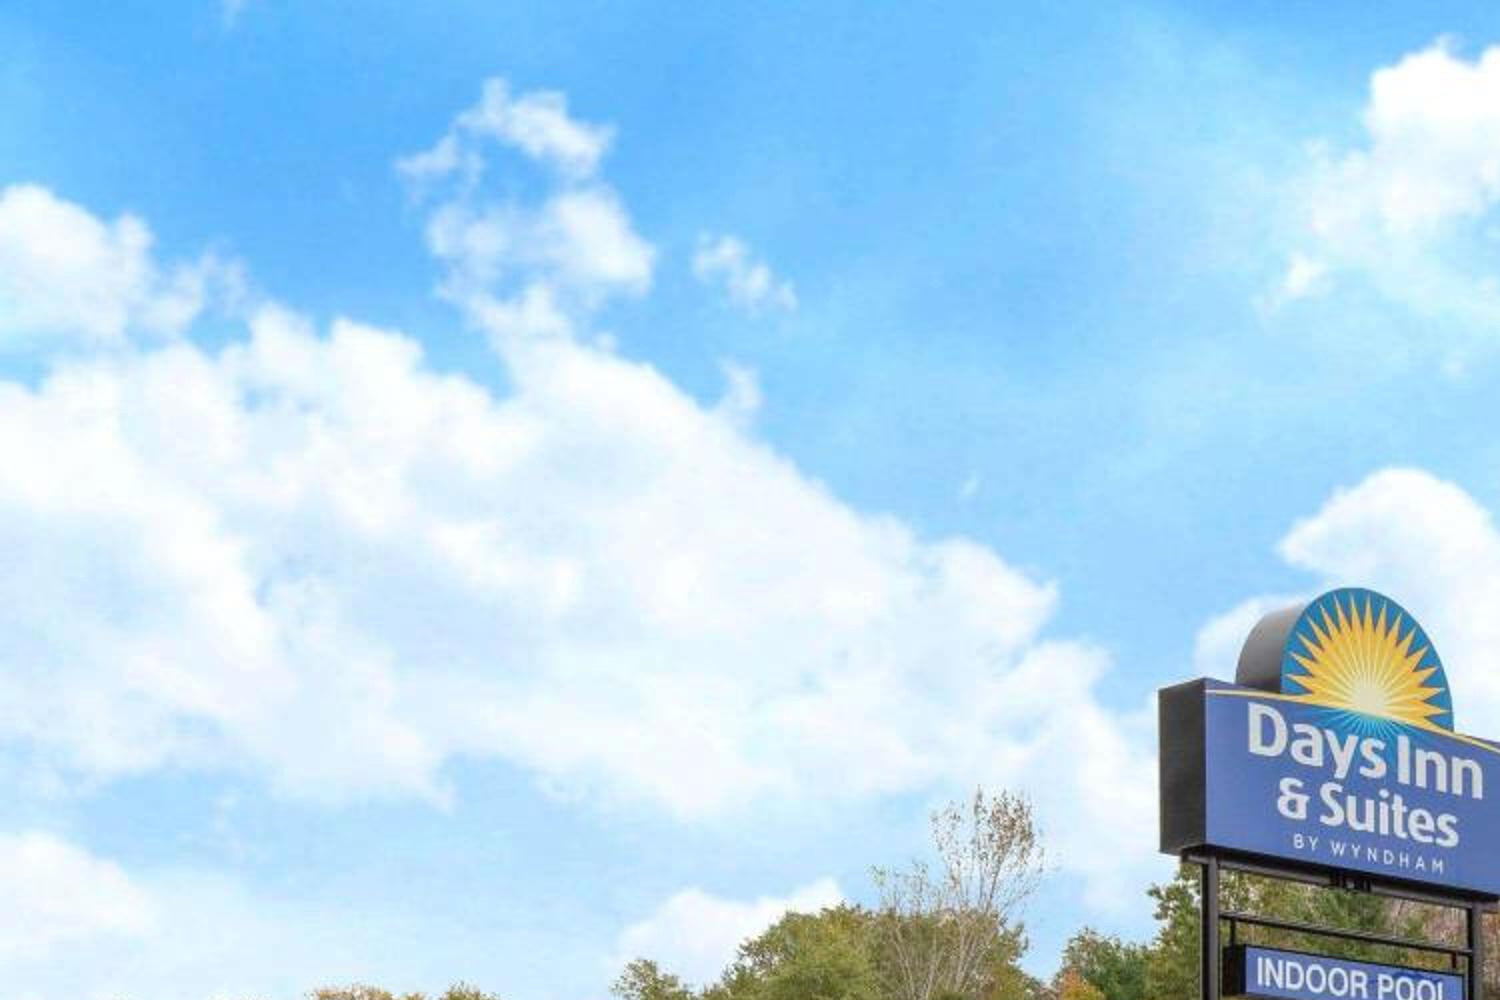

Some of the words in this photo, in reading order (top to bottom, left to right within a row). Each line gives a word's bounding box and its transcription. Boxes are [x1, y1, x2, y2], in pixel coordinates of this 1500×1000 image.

[1247, 701, 1387, 779] Days
[1397, 734, 1483, 800] Inn
[1276, 776, 1311, 820] &
[1319, 781, 1460, 848] Suites
[1293, 833, 1320, 850] BY
[1330, 840, 1444, 873] WYNDHAM
[1257, 956, 1369, 1000] INDOOR
